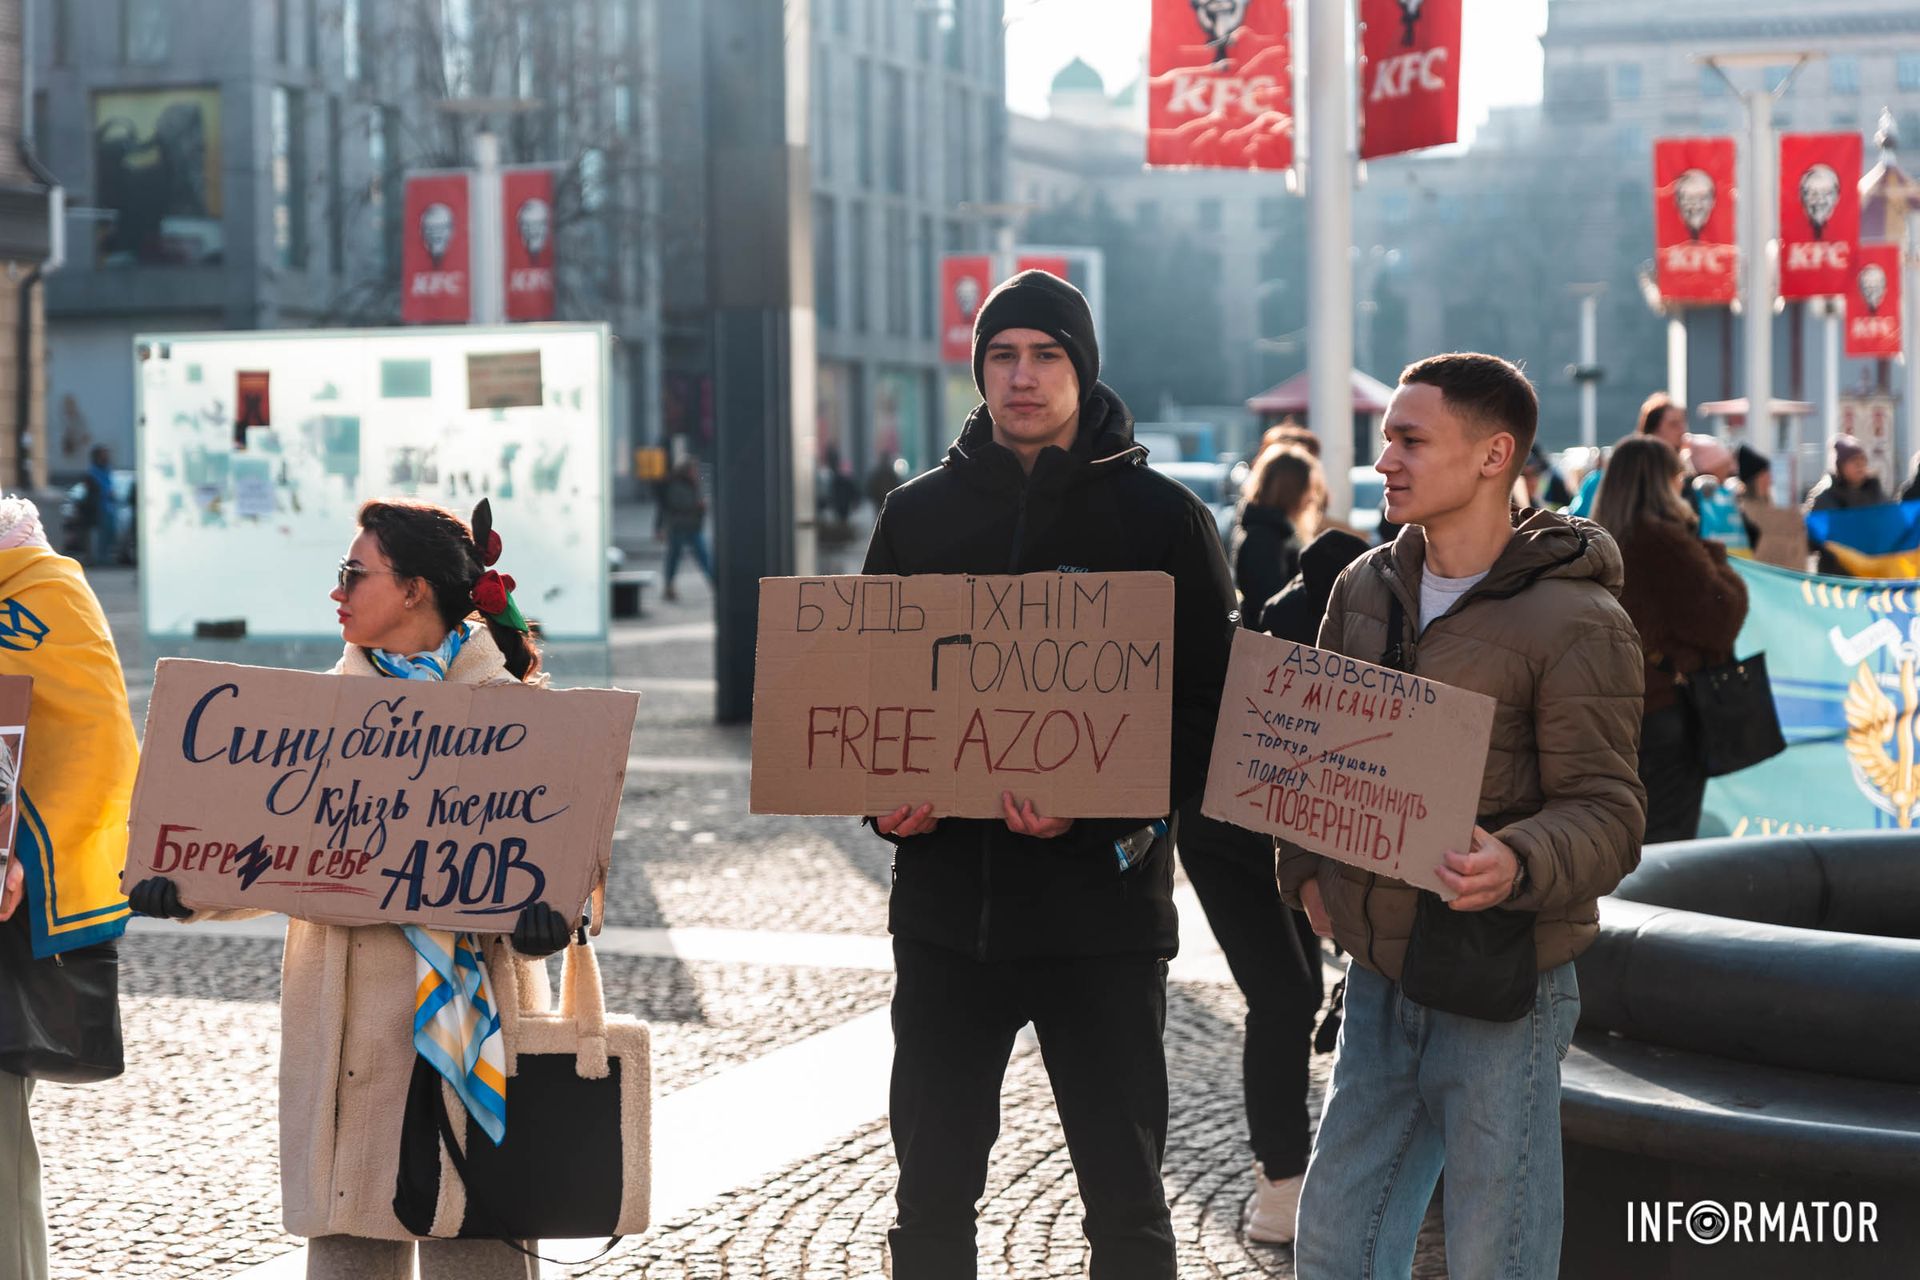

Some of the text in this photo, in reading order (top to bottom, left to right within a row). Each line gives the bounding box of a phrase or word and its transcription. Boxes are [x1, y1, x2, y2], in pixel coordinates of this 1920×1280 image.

[1167, 75, 1278, 115] KFC
[1370, 47, 1448, 102] KFC
[1666, 249, 1726, 273] KFC
[1787, 241, 1849, 271] KFC
[796, 575, 1109, 634] БУДЬ ЇХНІМ
[931, 633, 1161, 693] ГОЛОСОМ
[1262, 665, 1296, 699] 17
[1282, 644, 1437, 705] АЗОВСТАЛЬ
[807, 705, 1130, 775] FREE AZOV
[379, 836, 557, 915] АЗОВ
